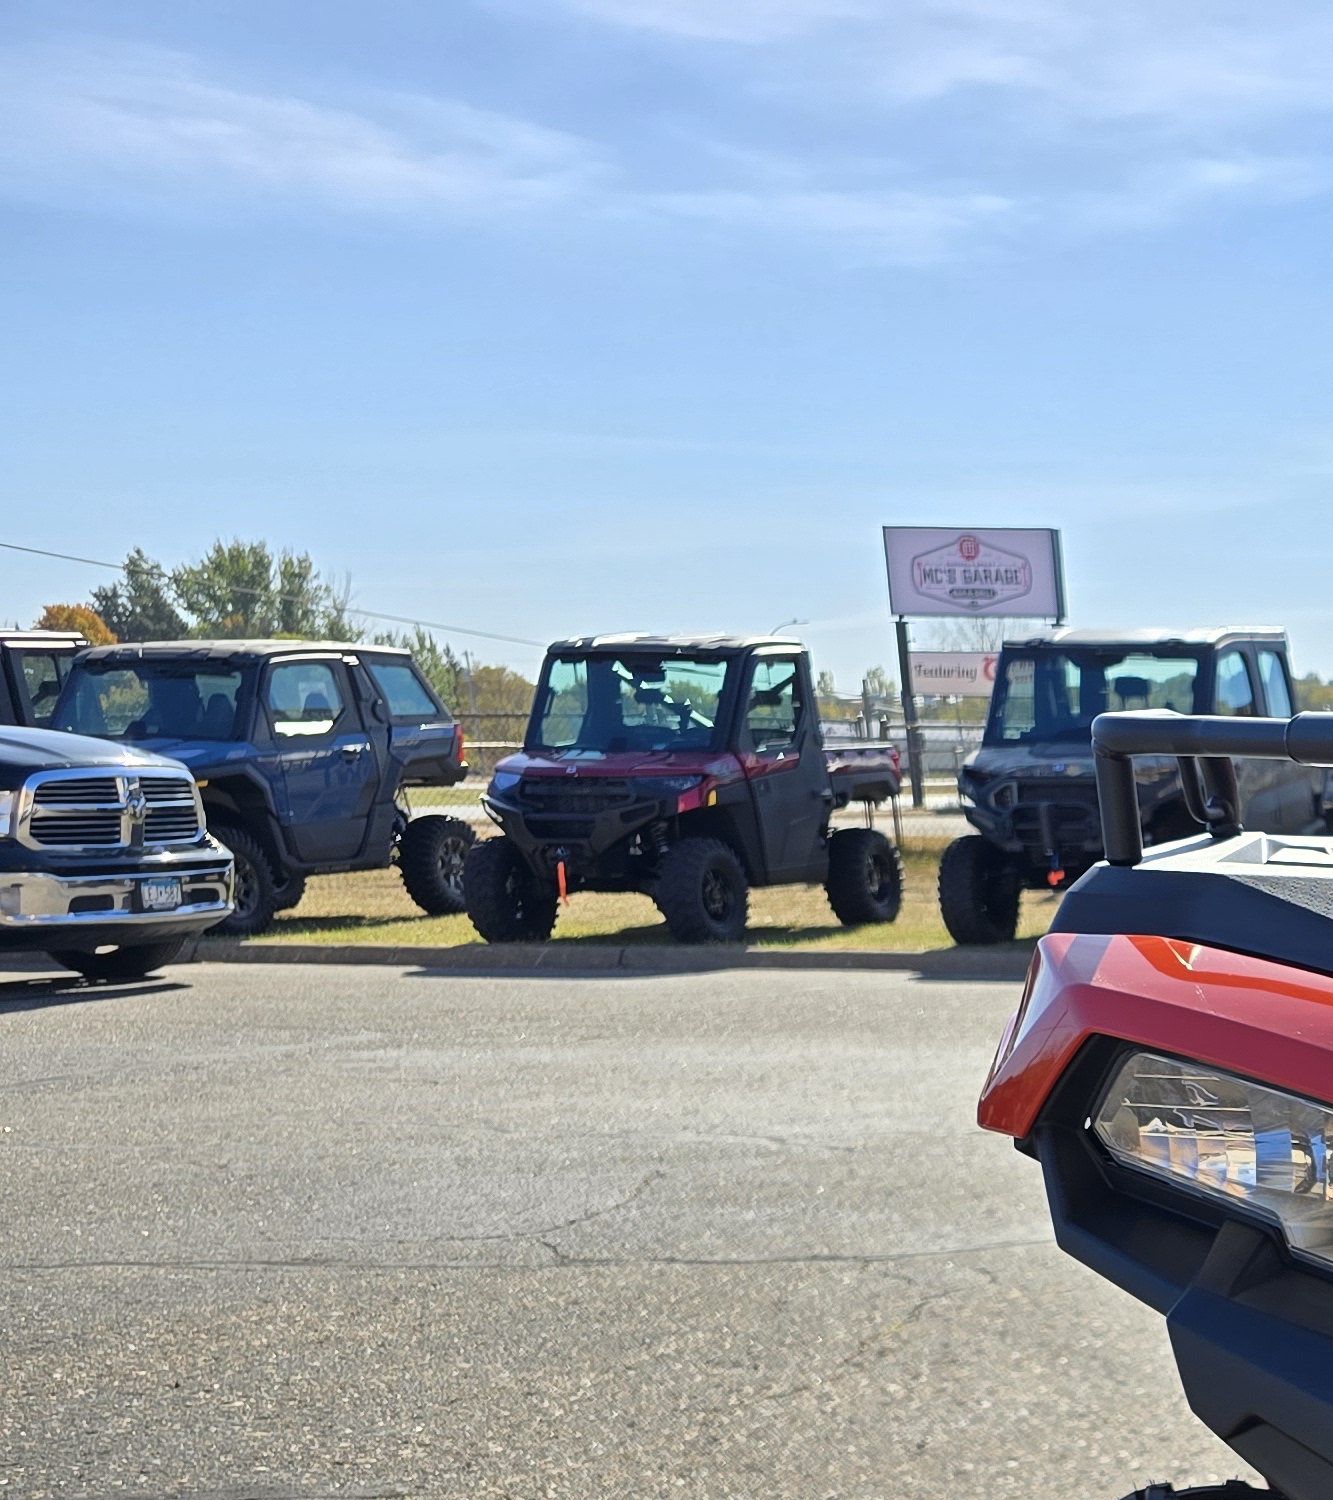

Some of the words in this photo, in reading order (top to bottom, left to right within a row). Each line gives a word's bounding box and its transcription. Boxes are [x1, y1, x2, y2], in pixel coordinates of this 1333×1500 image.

[923, 568, 957, 585] MC'S
[963, 568, 1022, 586] GARAGE
[914, 663, 977, 683] Featuring
